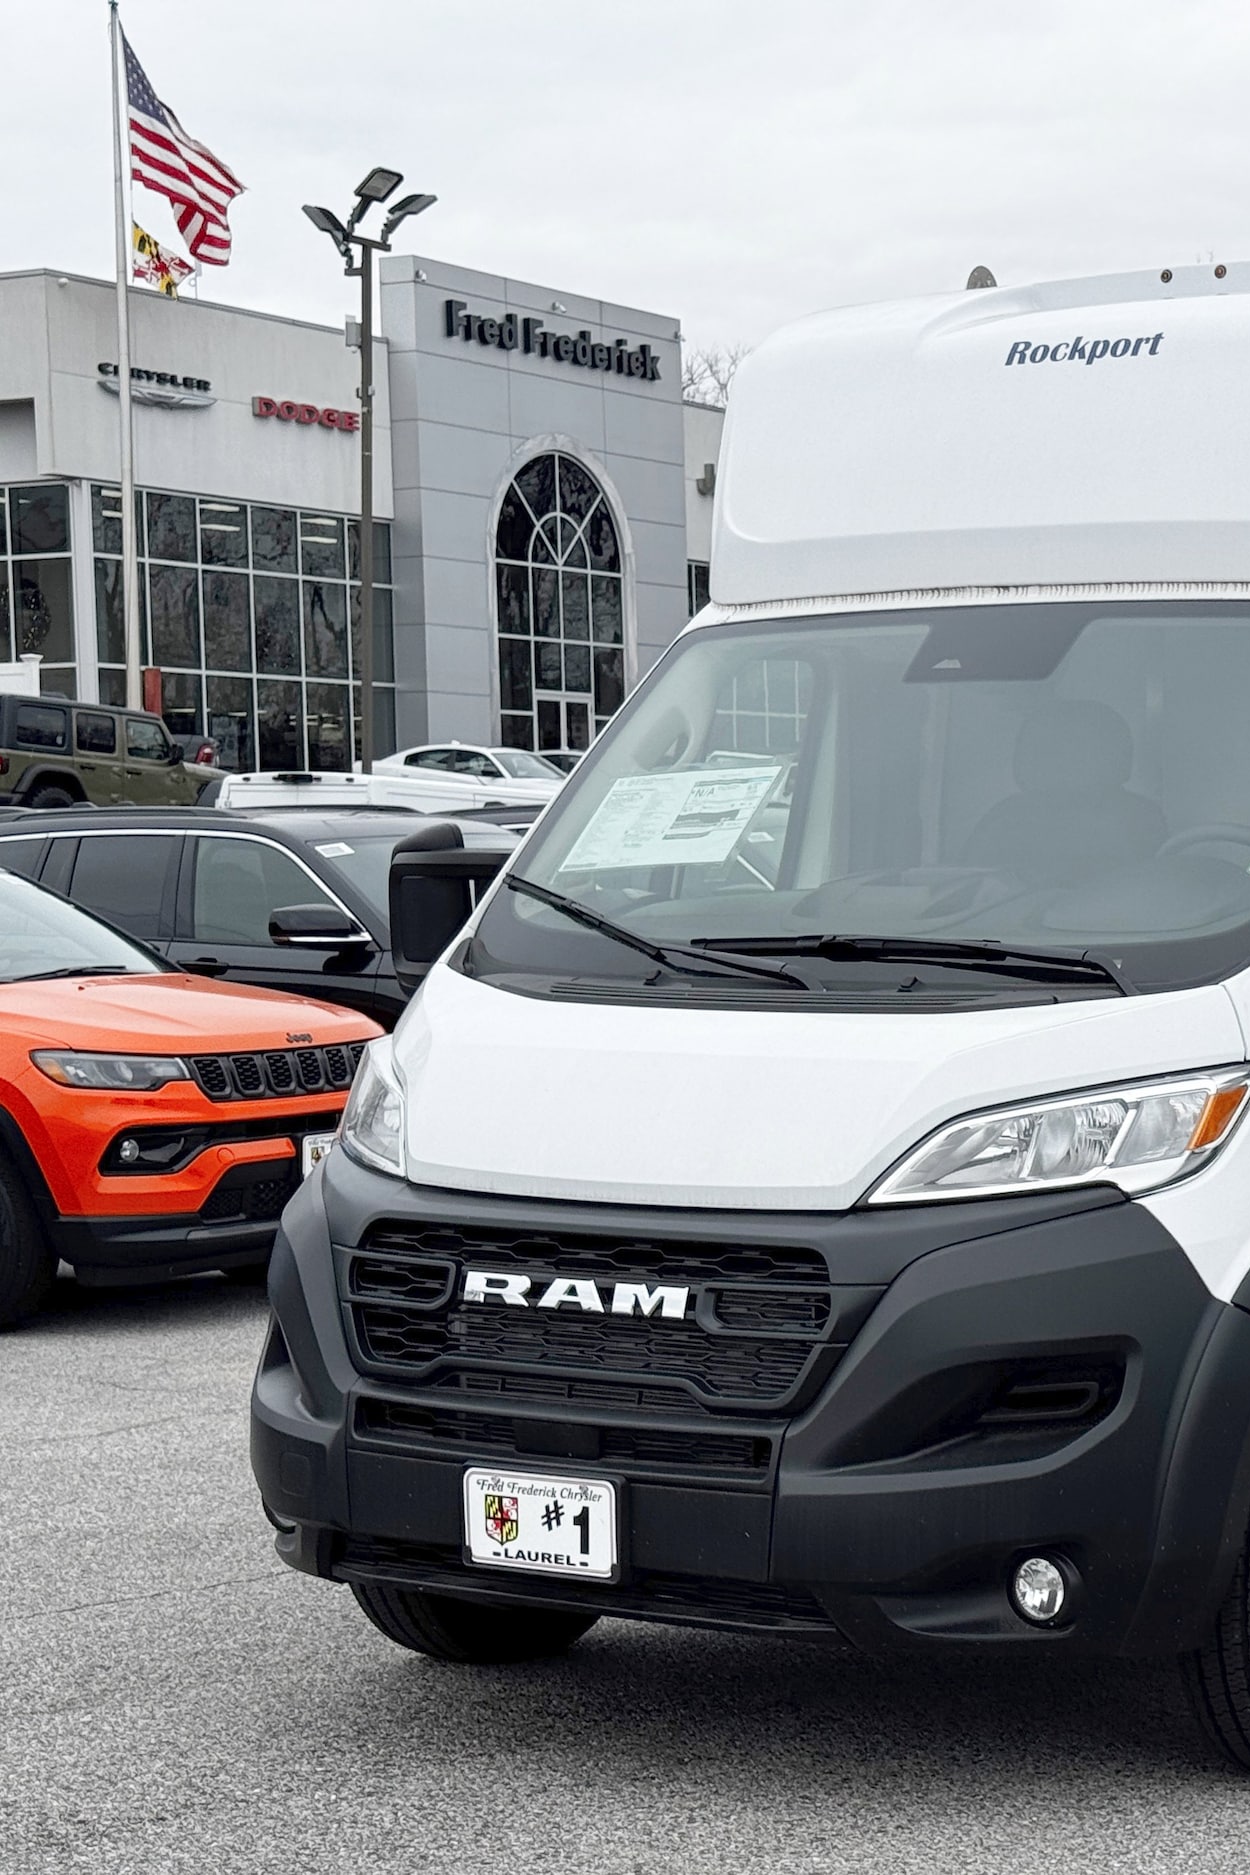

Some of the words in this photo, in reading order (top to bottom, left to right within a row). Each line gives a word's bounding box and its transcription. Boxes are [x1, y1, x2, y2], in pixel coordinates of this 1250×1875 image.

[445, 299, 519, 350] Fred
[522, 316, 662, 381] Frederick
[1005, 332, 1164, 366] Rockport
[252, 396, 360, 432] DODGE
[463, 1270, 690, 1320] RAM
[476, 1478, 504, 1492] Fred
[506, 1481, 557, 1498] Frederick
[559, 1487, 603, 1503] Chrysler
